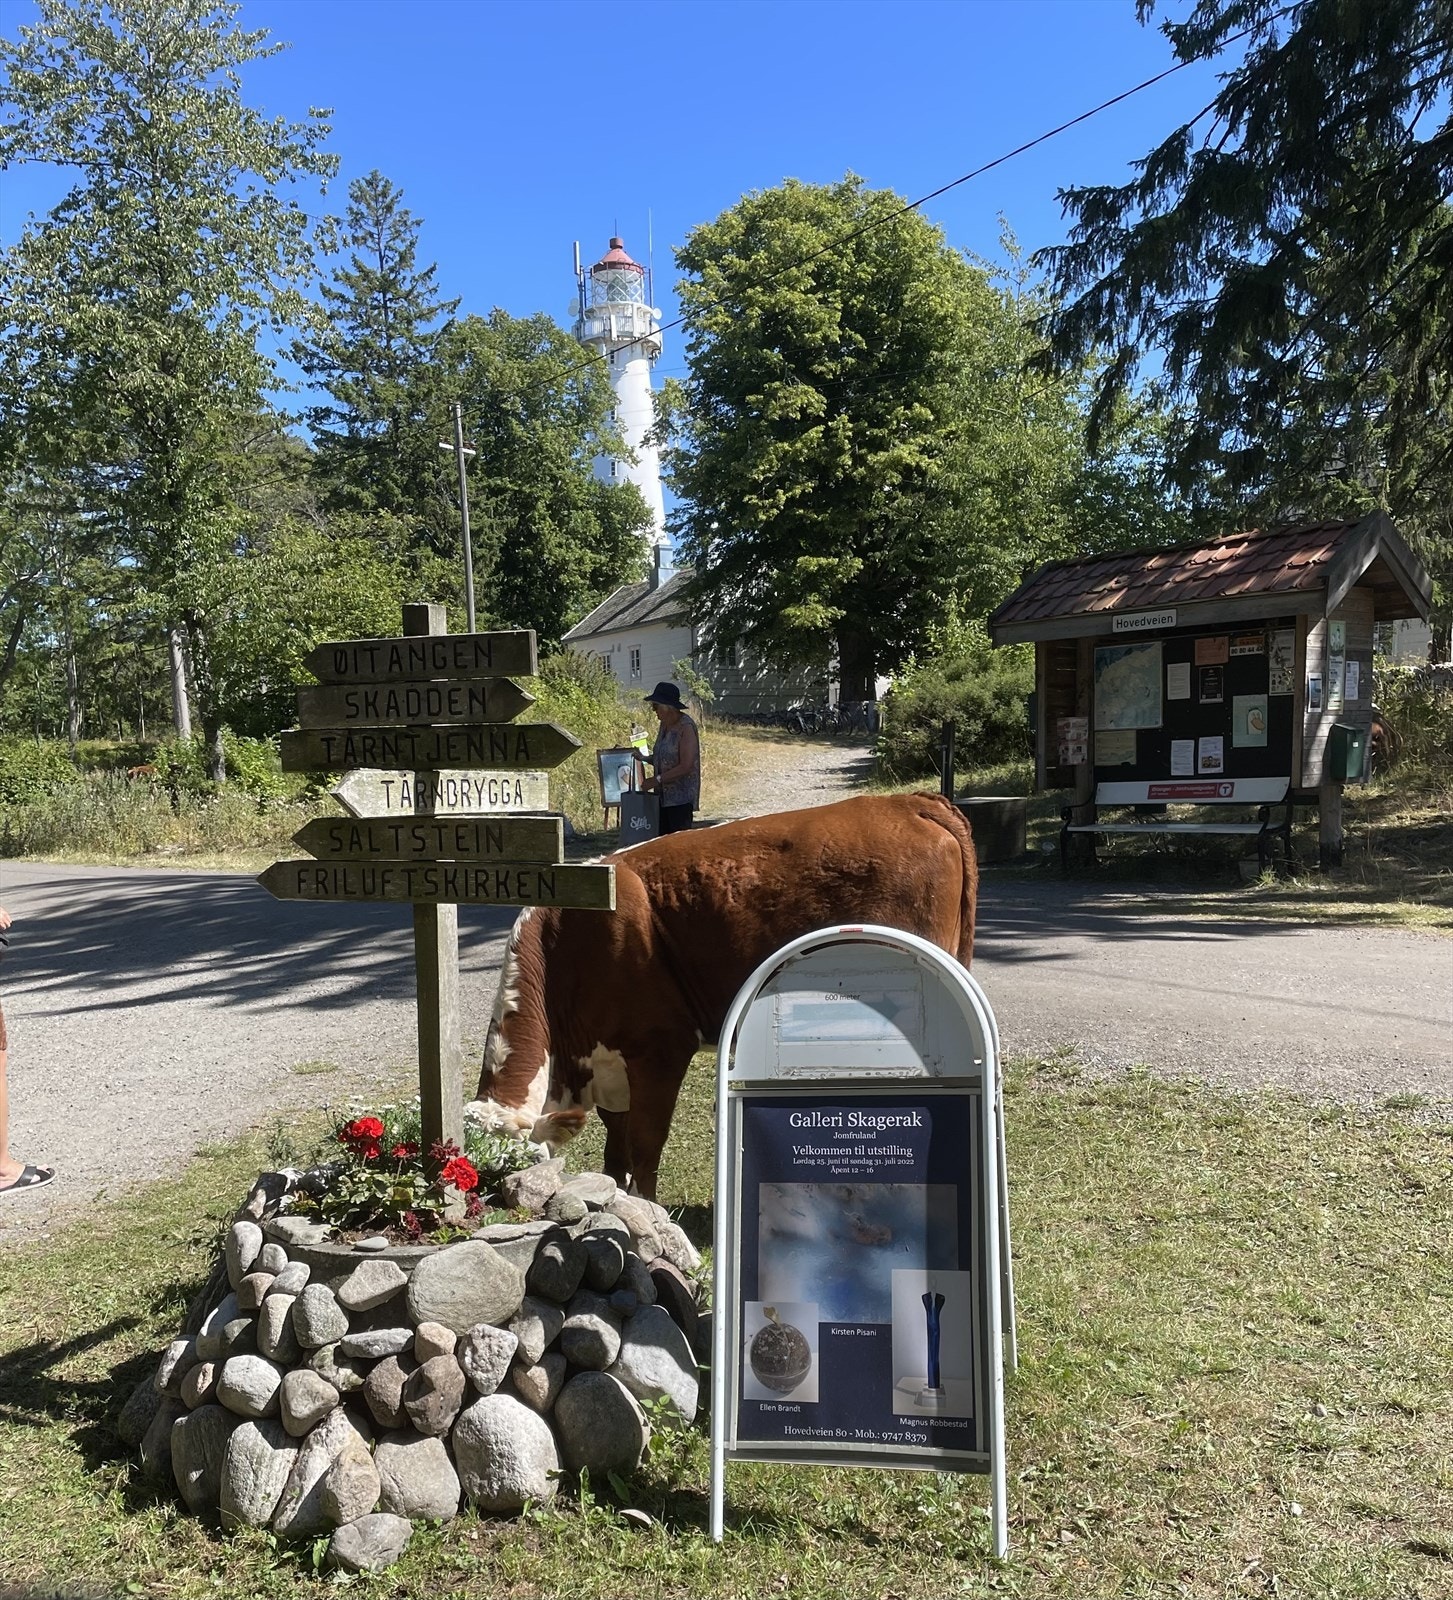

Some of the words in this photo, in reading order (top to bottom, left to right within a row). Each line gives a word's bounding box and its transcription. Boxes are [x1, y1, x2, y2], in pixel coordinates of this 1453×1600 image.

[1116, 615, 1173, 628] Hovedveien
[333, 638, 493, 675] ØITANGEN
[345, 686, 487, 719] SKADDEN
[380, 772, 524, 809] TÅRNBRYGGA
[329, 823, 504, 853] SALTSTEIN
[296, 867, 557, 900] FRILUFTSKIRKEN
[790, 1112, 843, 1128] Galleri
[848, 1112, 922, 1130] Skagerak
[833, 1132, 876, 1140] Jomfruland
[792, 1145, 851, 1156] Velkommen
[854, 1145, 865, 1156] til
[868, 1145, 913, 1157] utstilling
[793, 1158, 815, 1166] Lørdag
[827, 1158, 840, 1166] juni
[850, 1158, 873, 1166] søndag
[884, 1158, 896, 1166] juli
[830, 1166, 850, 1174] Åpent
[831, 1328, 855, 1336] Kirsten
[856, 1328, 877, 1336] Pisani
[900, 1418, 928, 1428] Magnus
[930, 1419, 968, 1428] Robbestad
[784, 1425, 834, 1437] Hovedveien
[835, 1428, 847, 1437] 80
[855, 1429, 880, 1439] Mob.:
[882, 1432, 903, 1442] 9747
[905, 1432, 927, 1443] 8379
